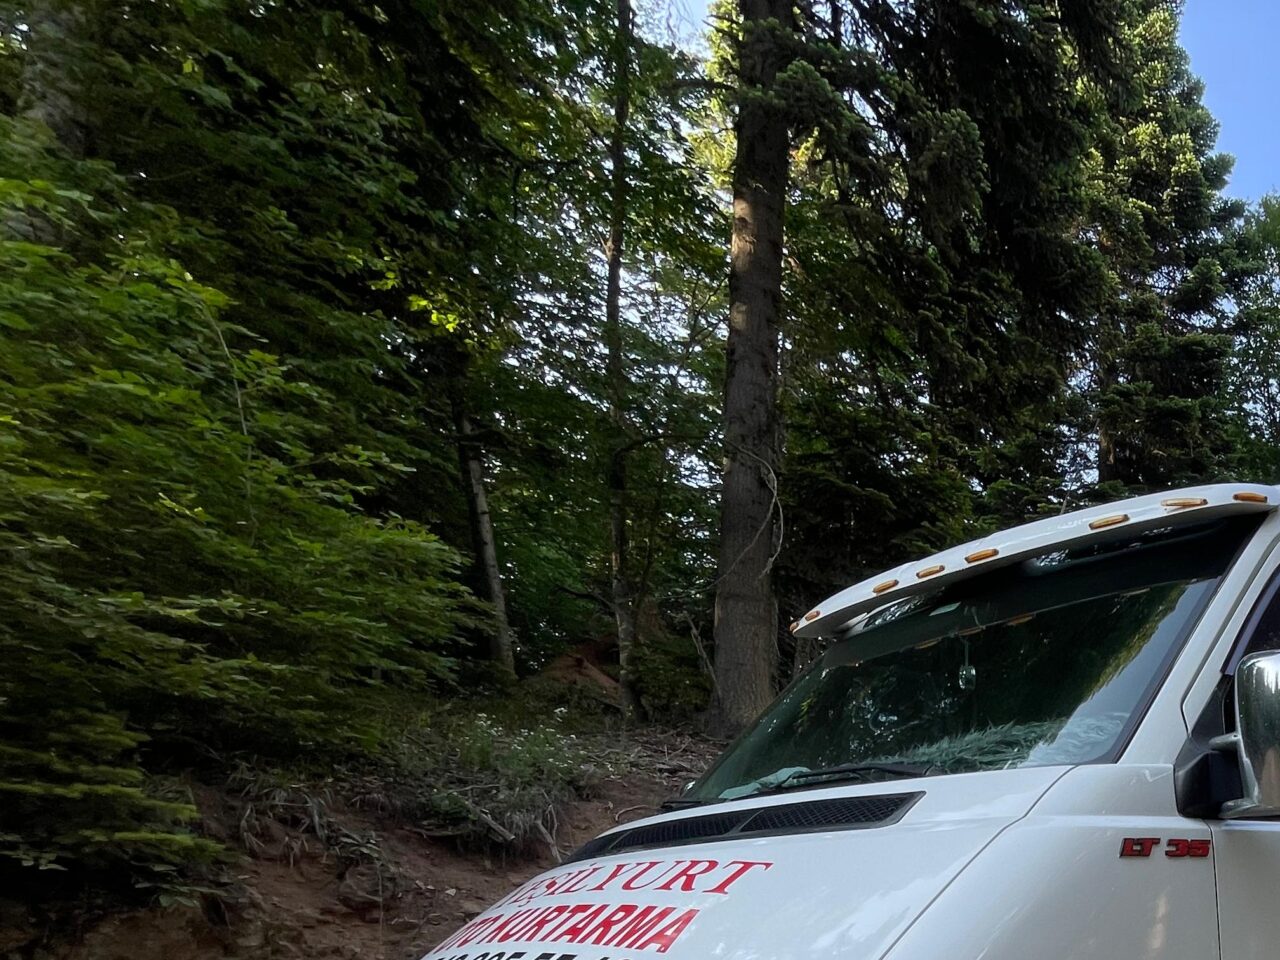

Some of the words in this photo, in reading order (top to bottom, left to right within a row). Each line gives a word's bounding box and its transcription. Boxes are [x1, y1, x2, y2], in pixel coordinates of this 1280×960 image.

[1119, 837, 1161, 858] LT
[1165, 838, 1211, 857] 35
[476, 904, 700, 953] KURTARMA
